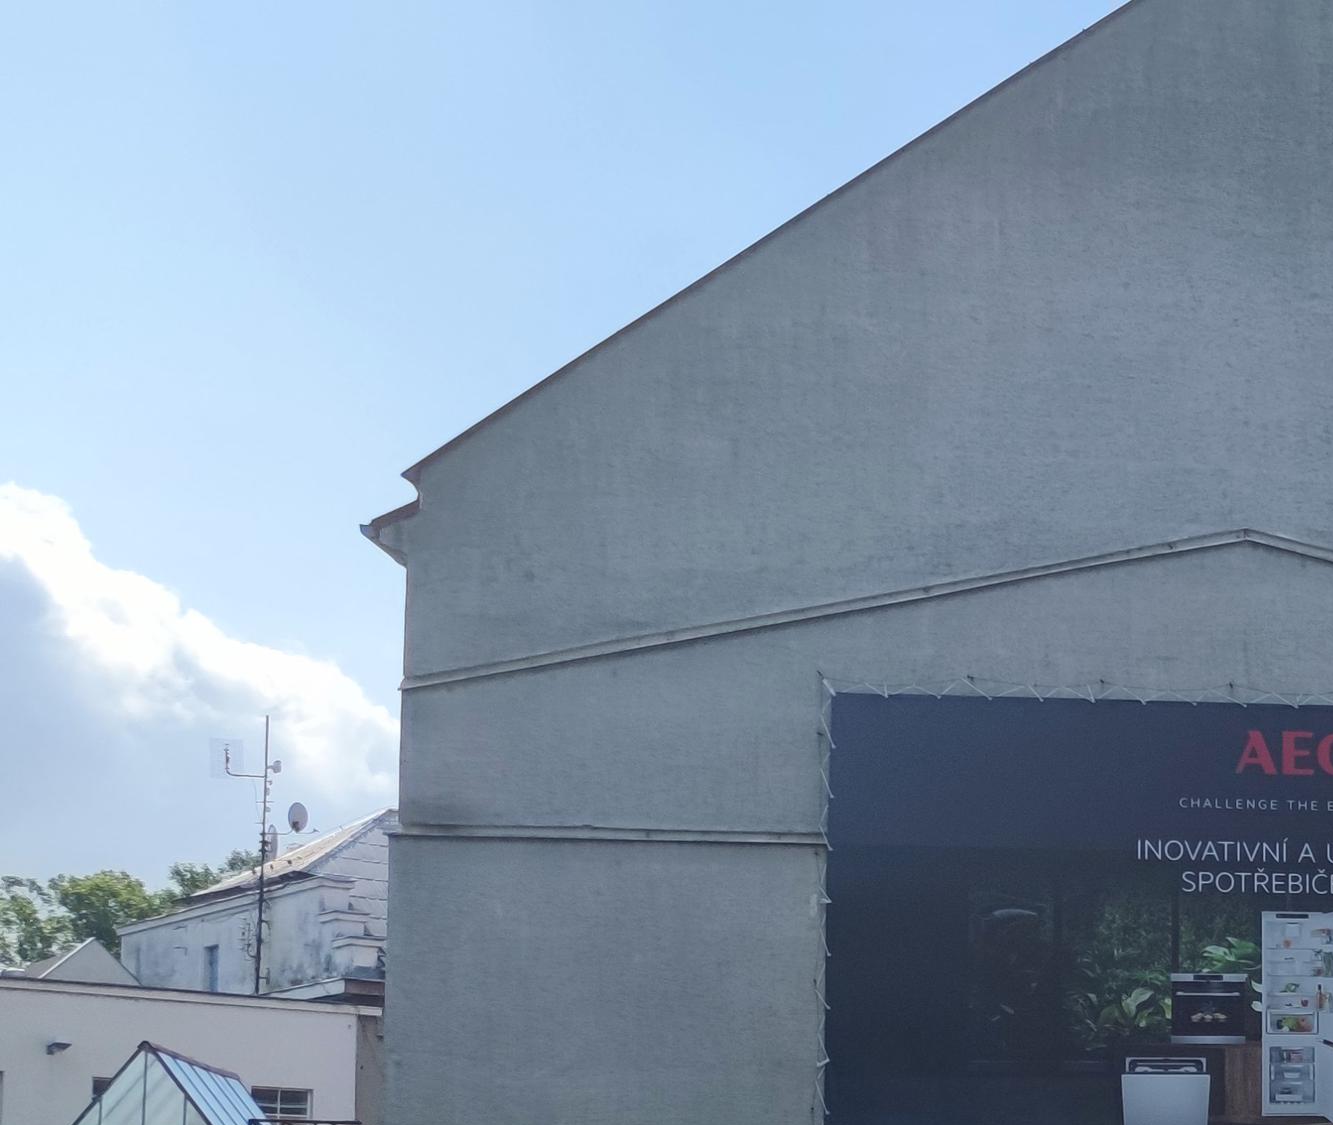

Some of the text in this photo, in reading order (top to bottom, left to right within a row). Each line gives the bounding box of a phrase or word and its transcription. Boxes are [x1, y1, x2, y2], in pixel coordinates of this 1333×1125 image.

[1179, 797, 1278, 811] CHALLENGE
[1288, 800, 1318, 811] THE
[1137, 837, 1288, 864] INOVATIVNÍ
[1298, 842, 1316, 864] A
